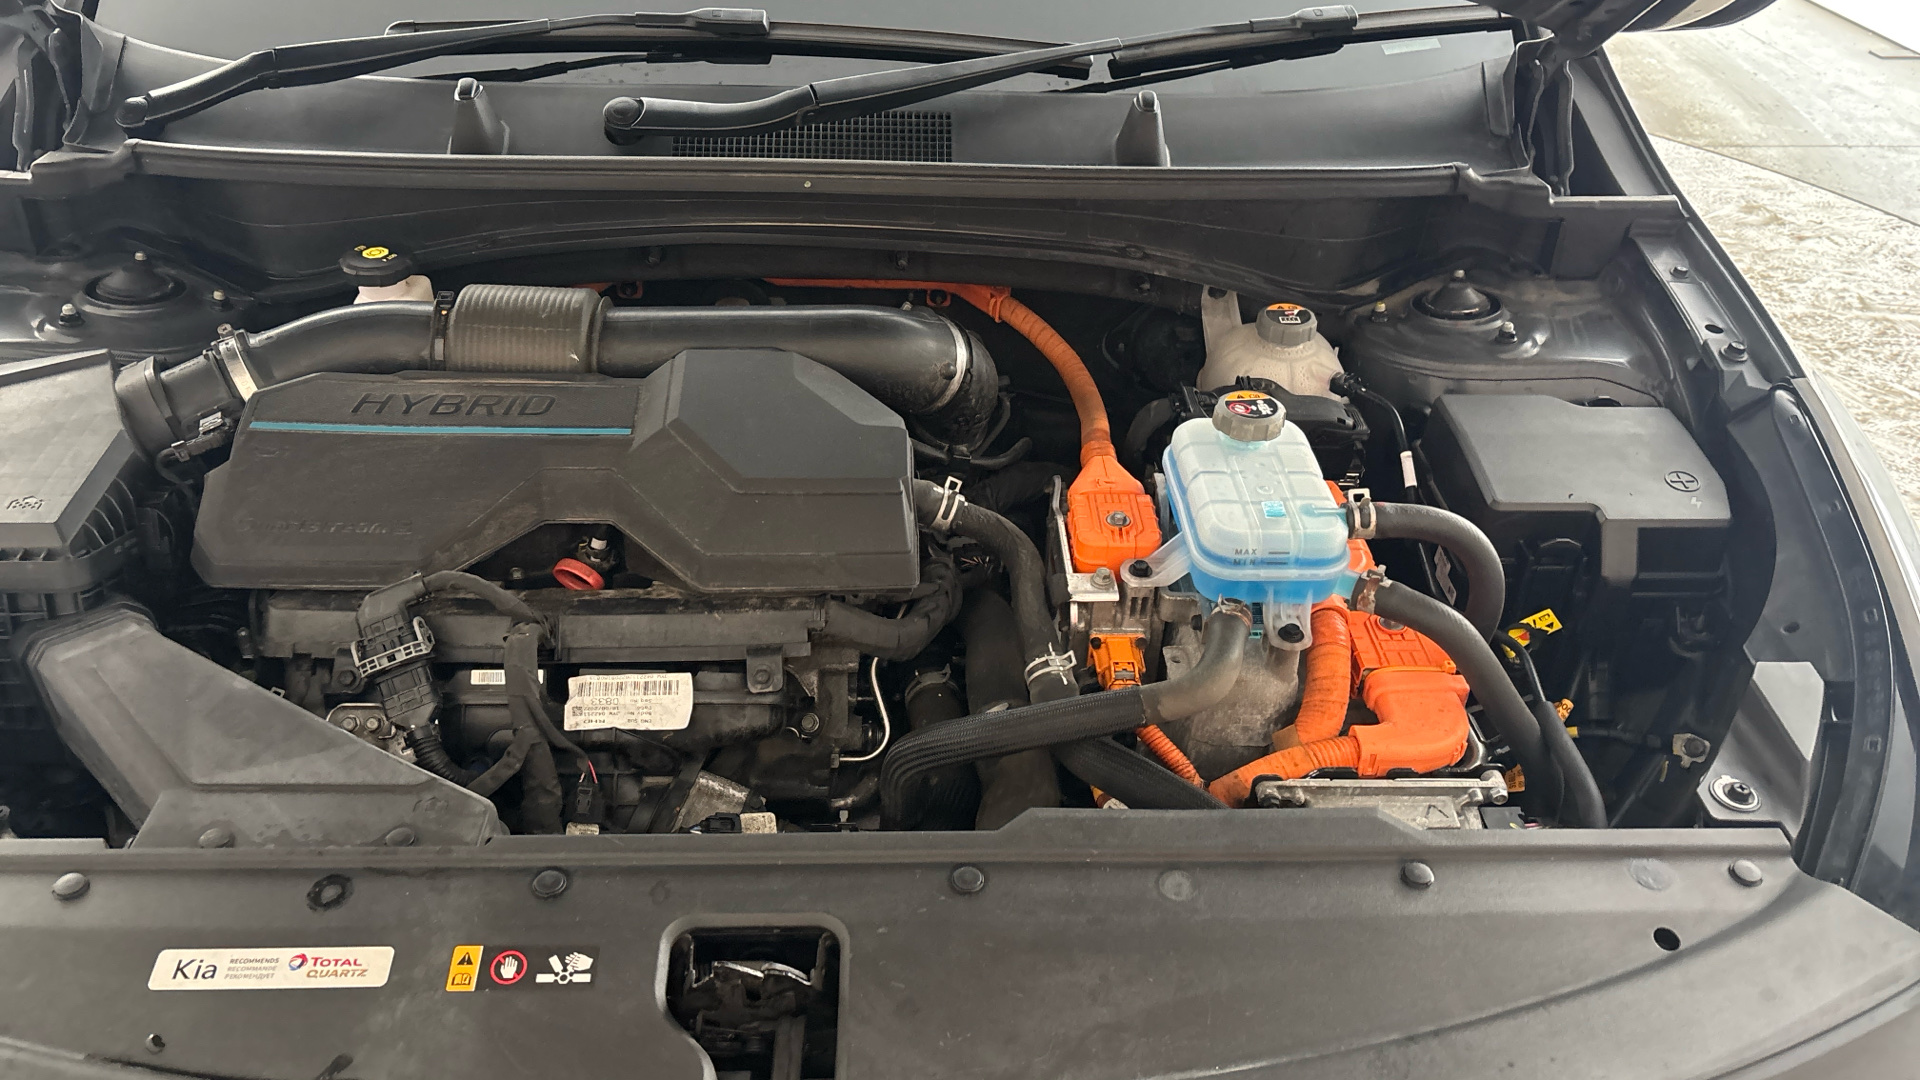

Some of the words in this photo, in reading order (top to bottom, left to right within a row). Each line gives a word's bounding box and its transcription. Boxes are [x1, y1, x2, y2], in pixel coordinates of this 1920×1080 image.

[351, 392, 557, 416] HYBRID
[1234, 548, 1258, 556] MAX
[1232, 558, 1256, 566] MIN
[229, 957, 281, 965] RECOMMENDS
[310, 956, 363, 967] TOTAL
[171, 958, 218, 980] Kia
[305, 969, 369, 979] QUARTZ
